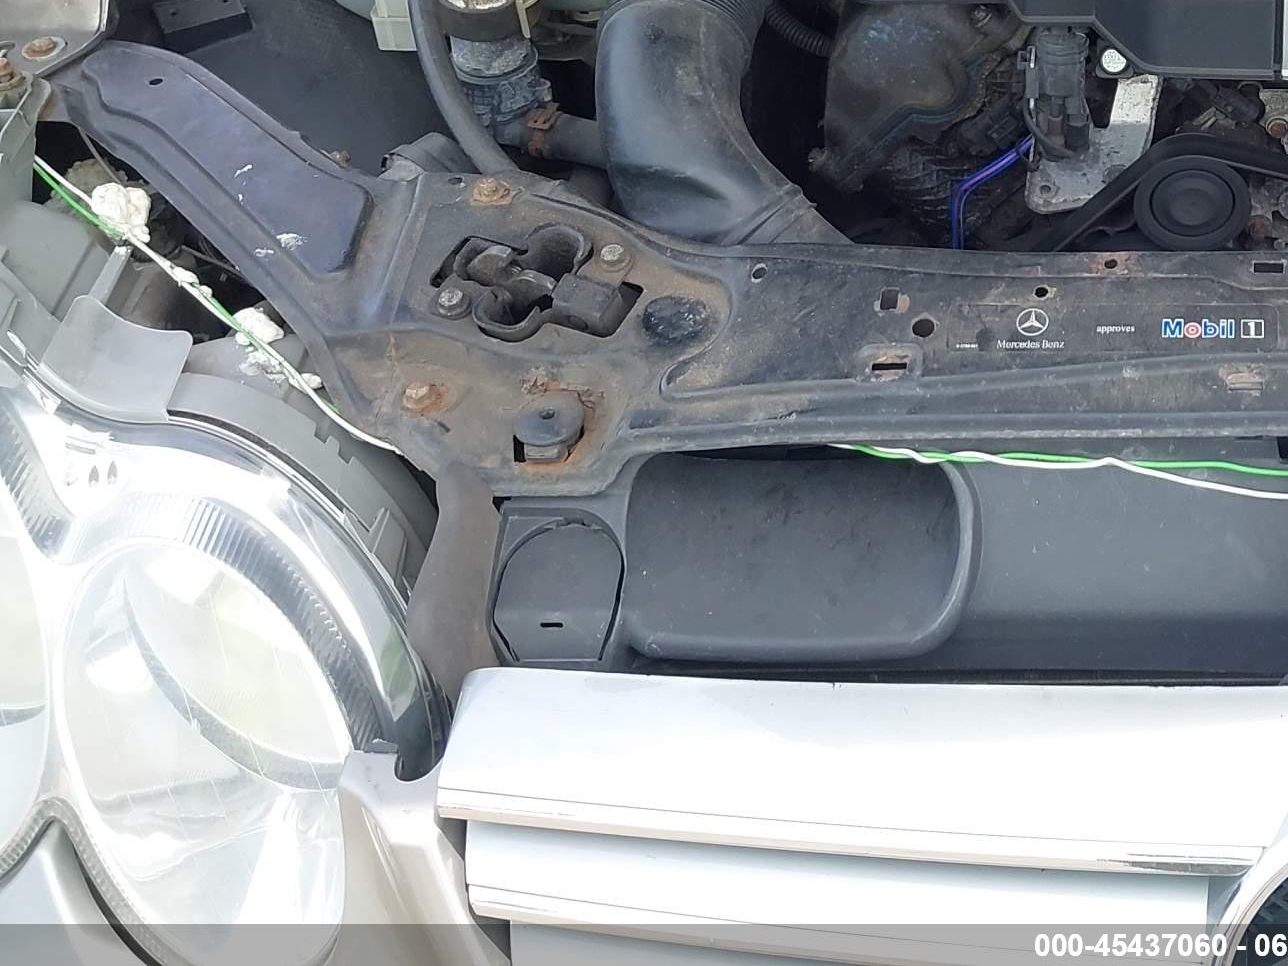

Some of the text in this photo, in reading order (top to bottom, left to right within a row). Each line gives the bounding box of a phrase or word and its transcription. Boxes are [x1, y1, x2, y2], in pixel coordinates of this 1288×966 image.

[1096, 324, 1135, 334] approves
[1162, 318, 1235, 339] Mobil
[996, 339, 1065, 349] Mercedes Benz
